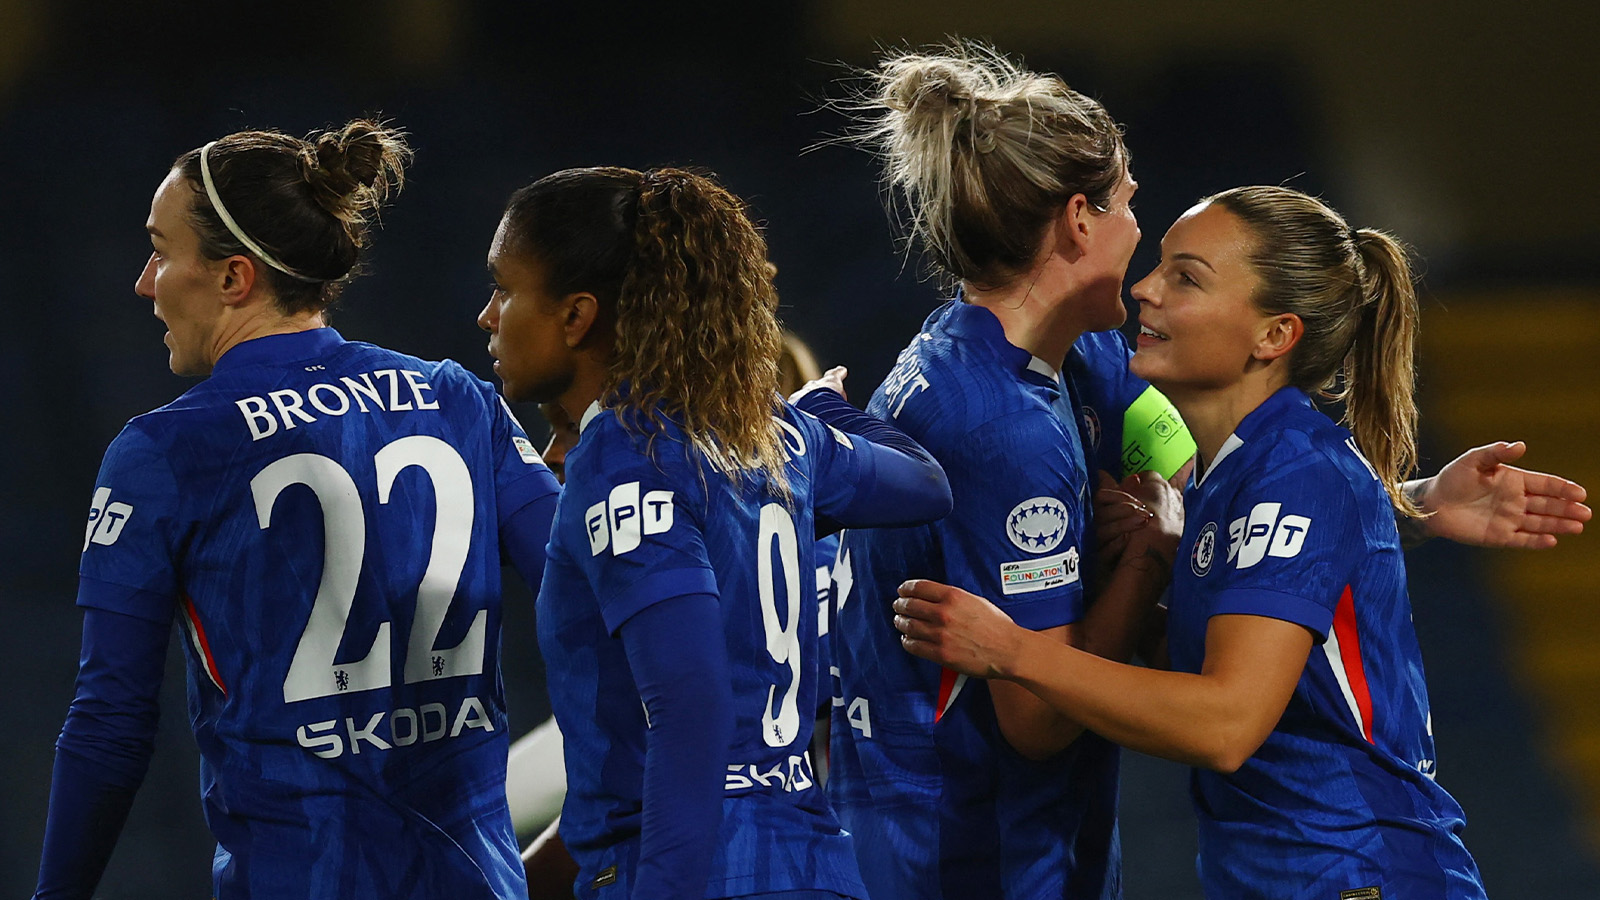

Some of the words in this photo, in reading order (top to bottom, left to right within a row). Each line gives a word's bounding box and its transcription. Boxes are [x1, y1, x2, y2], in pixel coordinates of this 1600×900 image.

[235, 369, 440, 442] BRONZE
[584, 499, 673, 546] FPT
[249, 435, 487, 703] 22
[1003, 564, 1020, 572] UEFA
[1004, 567, 1063, 583] FOUNDATION
[758, 503, 801, 748] 9
